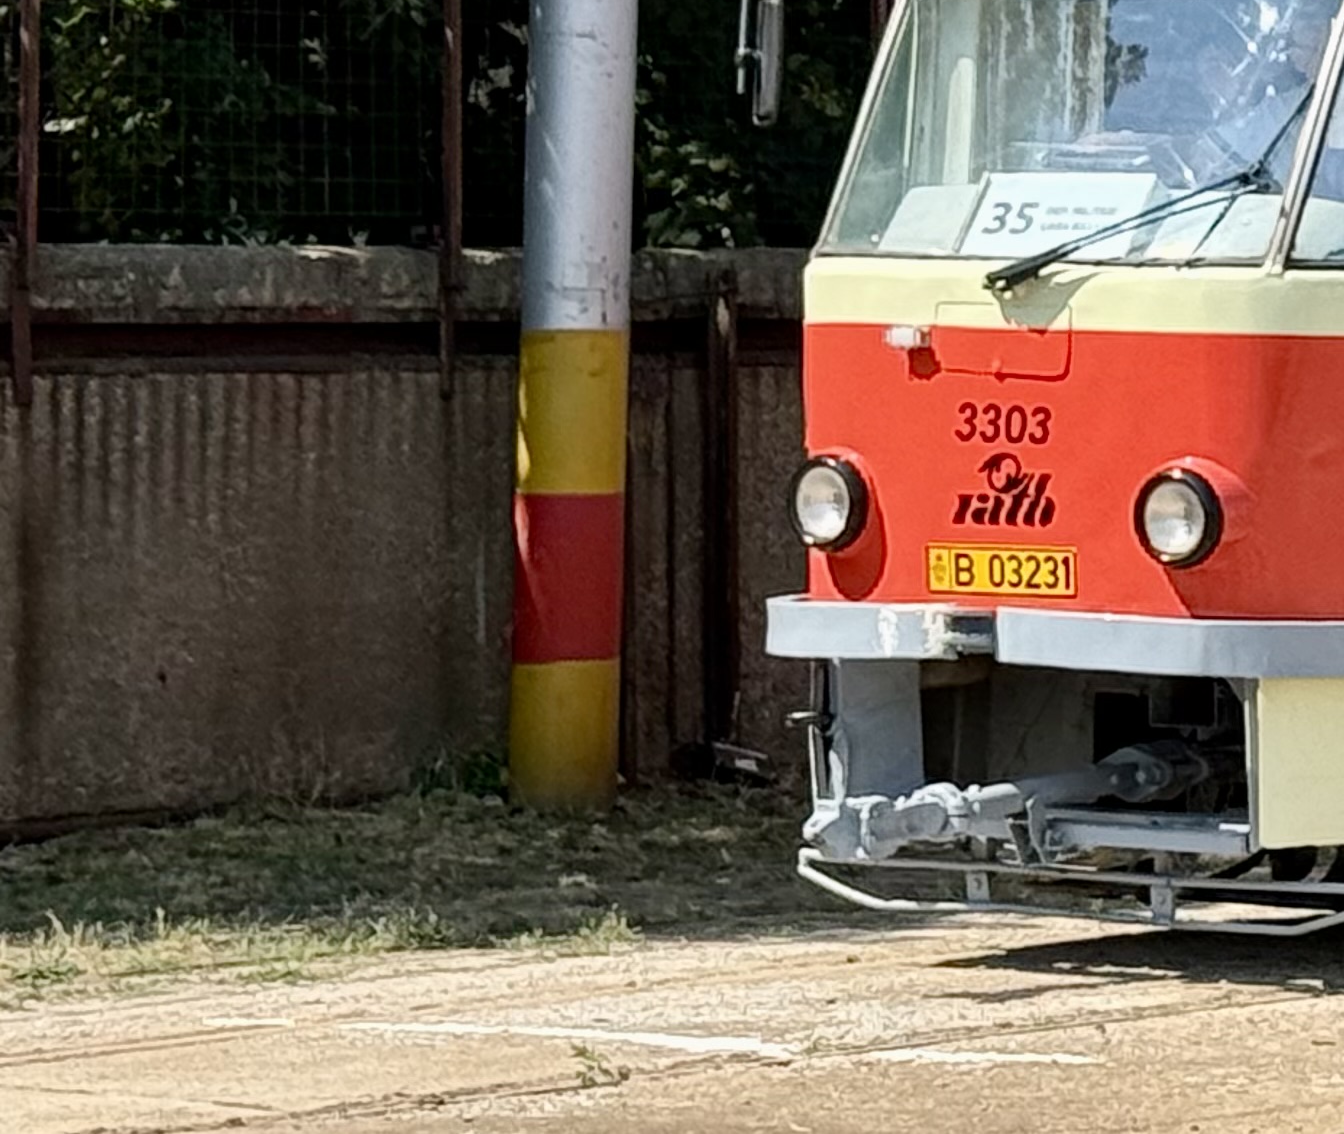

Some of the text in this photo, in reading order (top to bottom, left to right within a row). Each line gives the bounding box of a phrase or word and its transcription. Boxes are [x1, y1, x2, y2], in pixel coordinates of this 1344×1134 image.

[981, 202, 1039, 234] 35
[954, 402, 1052, 445] 3303
[954, 553, 1071, 589] B 03231
